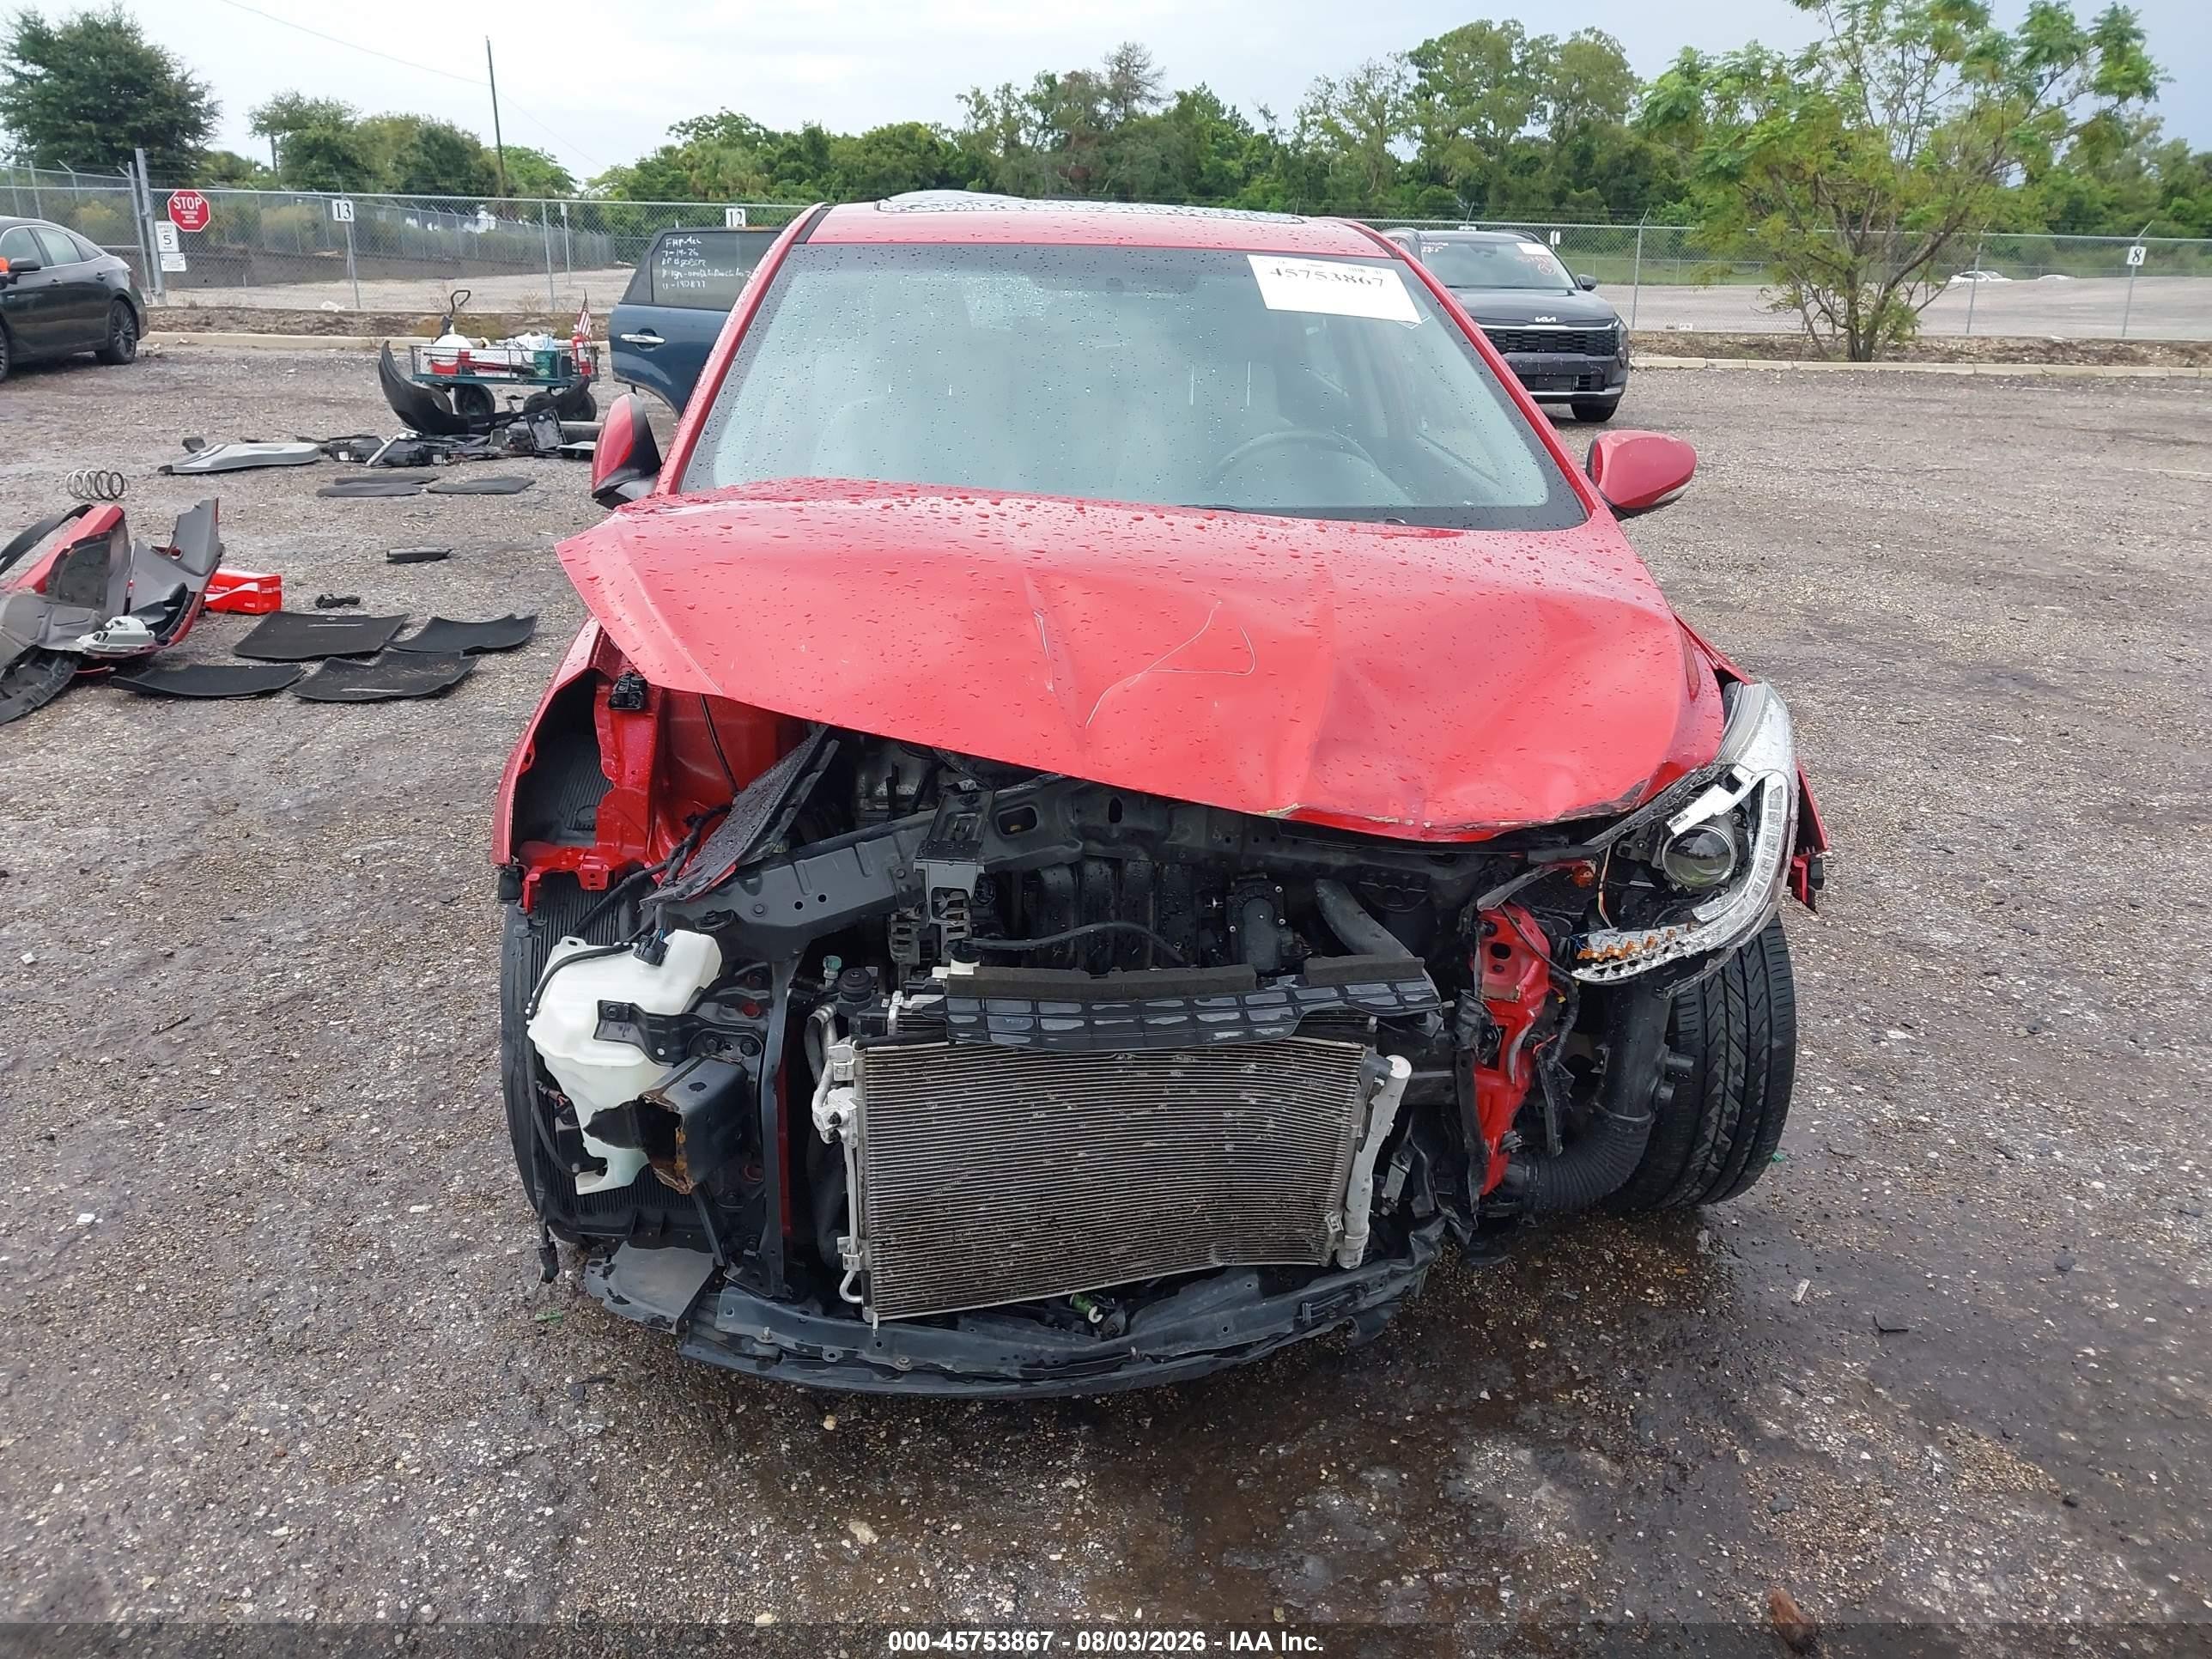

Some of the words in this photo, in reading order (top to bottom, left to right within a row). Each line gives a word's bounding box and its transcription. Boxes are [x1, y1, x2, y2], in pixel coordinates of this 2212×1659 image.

[173, 196, 202, 210] STOP
[336, 203, 351, 220] 13
[728, 211, 743, 227] 12
[163, 234, 172, 246] 5
[2132, 248, 2142, 263] 8
[1270, 267, 1384, 288] 45753867
